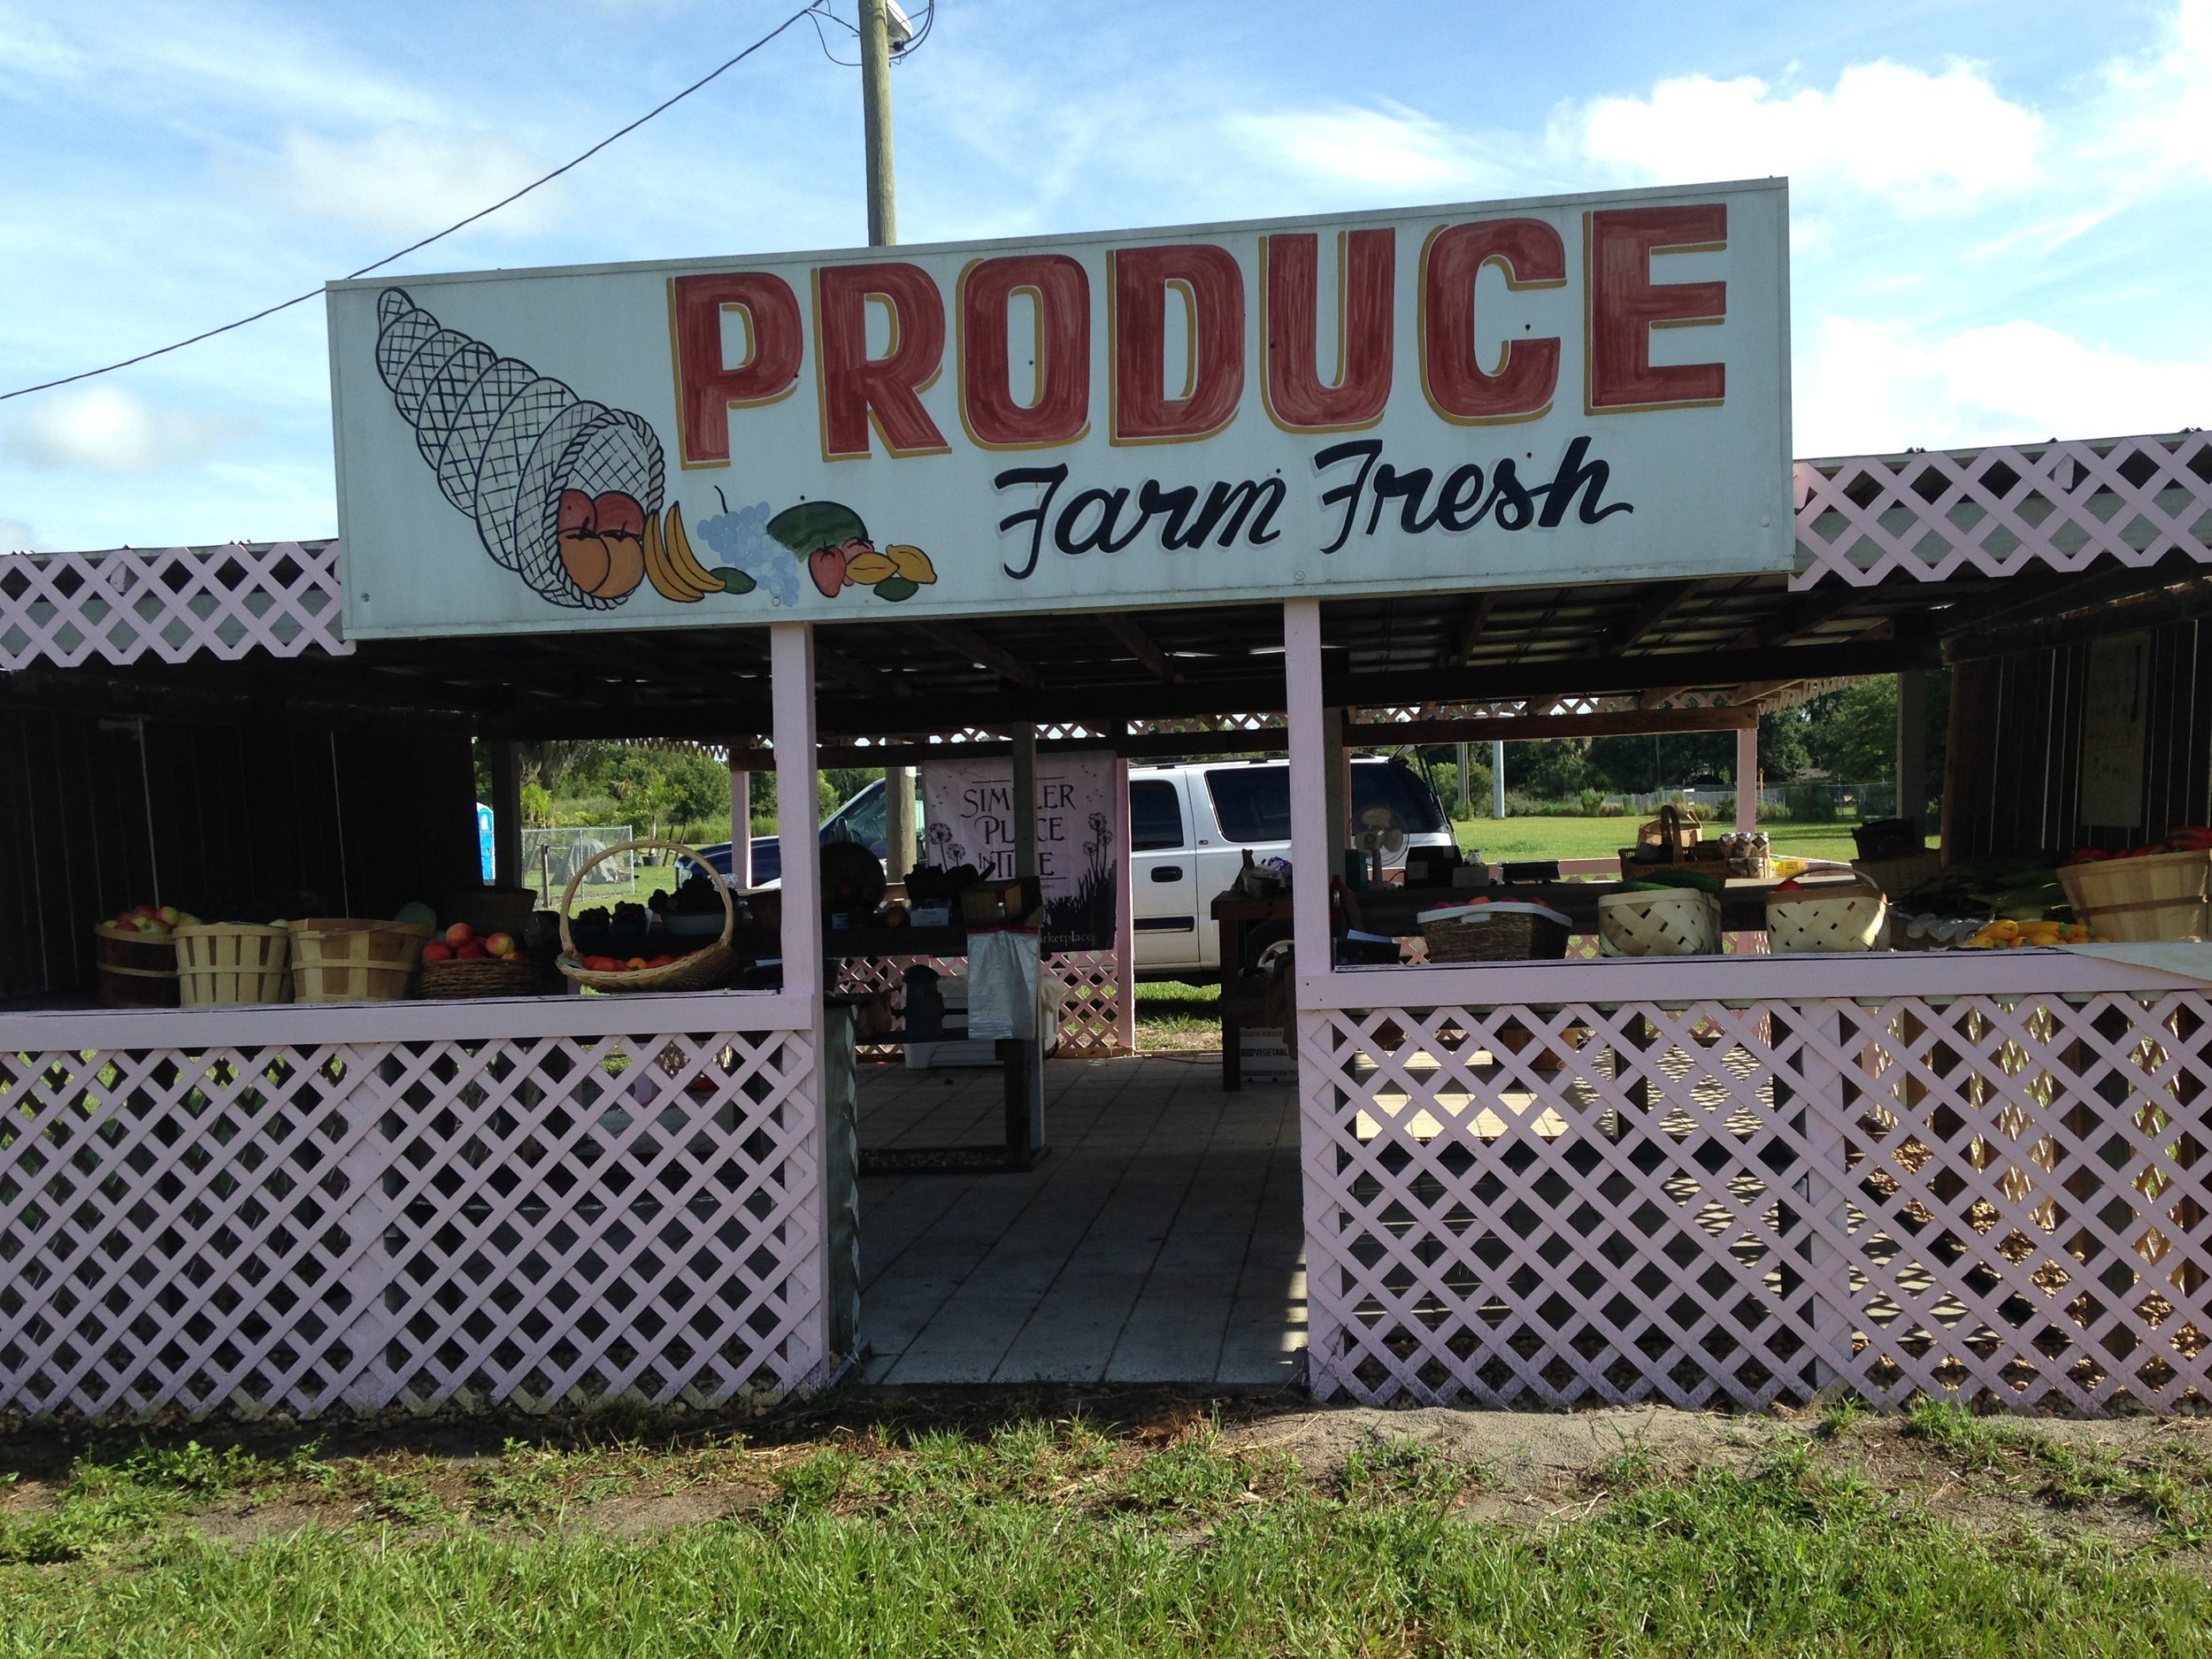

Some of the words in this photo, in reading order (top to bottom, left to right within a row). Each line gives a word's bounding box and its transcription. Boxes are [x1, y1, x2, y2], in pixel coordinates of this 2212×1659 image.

[666, 204, 1727, 470] PRODUCE
[993, 463, 1287, 580] Farm
[1312, 436, 1633, 554] Fresh
[974, 815, 1065, 845] PLCE
[990, 849, 1055, 878] TIE
[1253, 1048, 1289, 1057] VEGETABL
